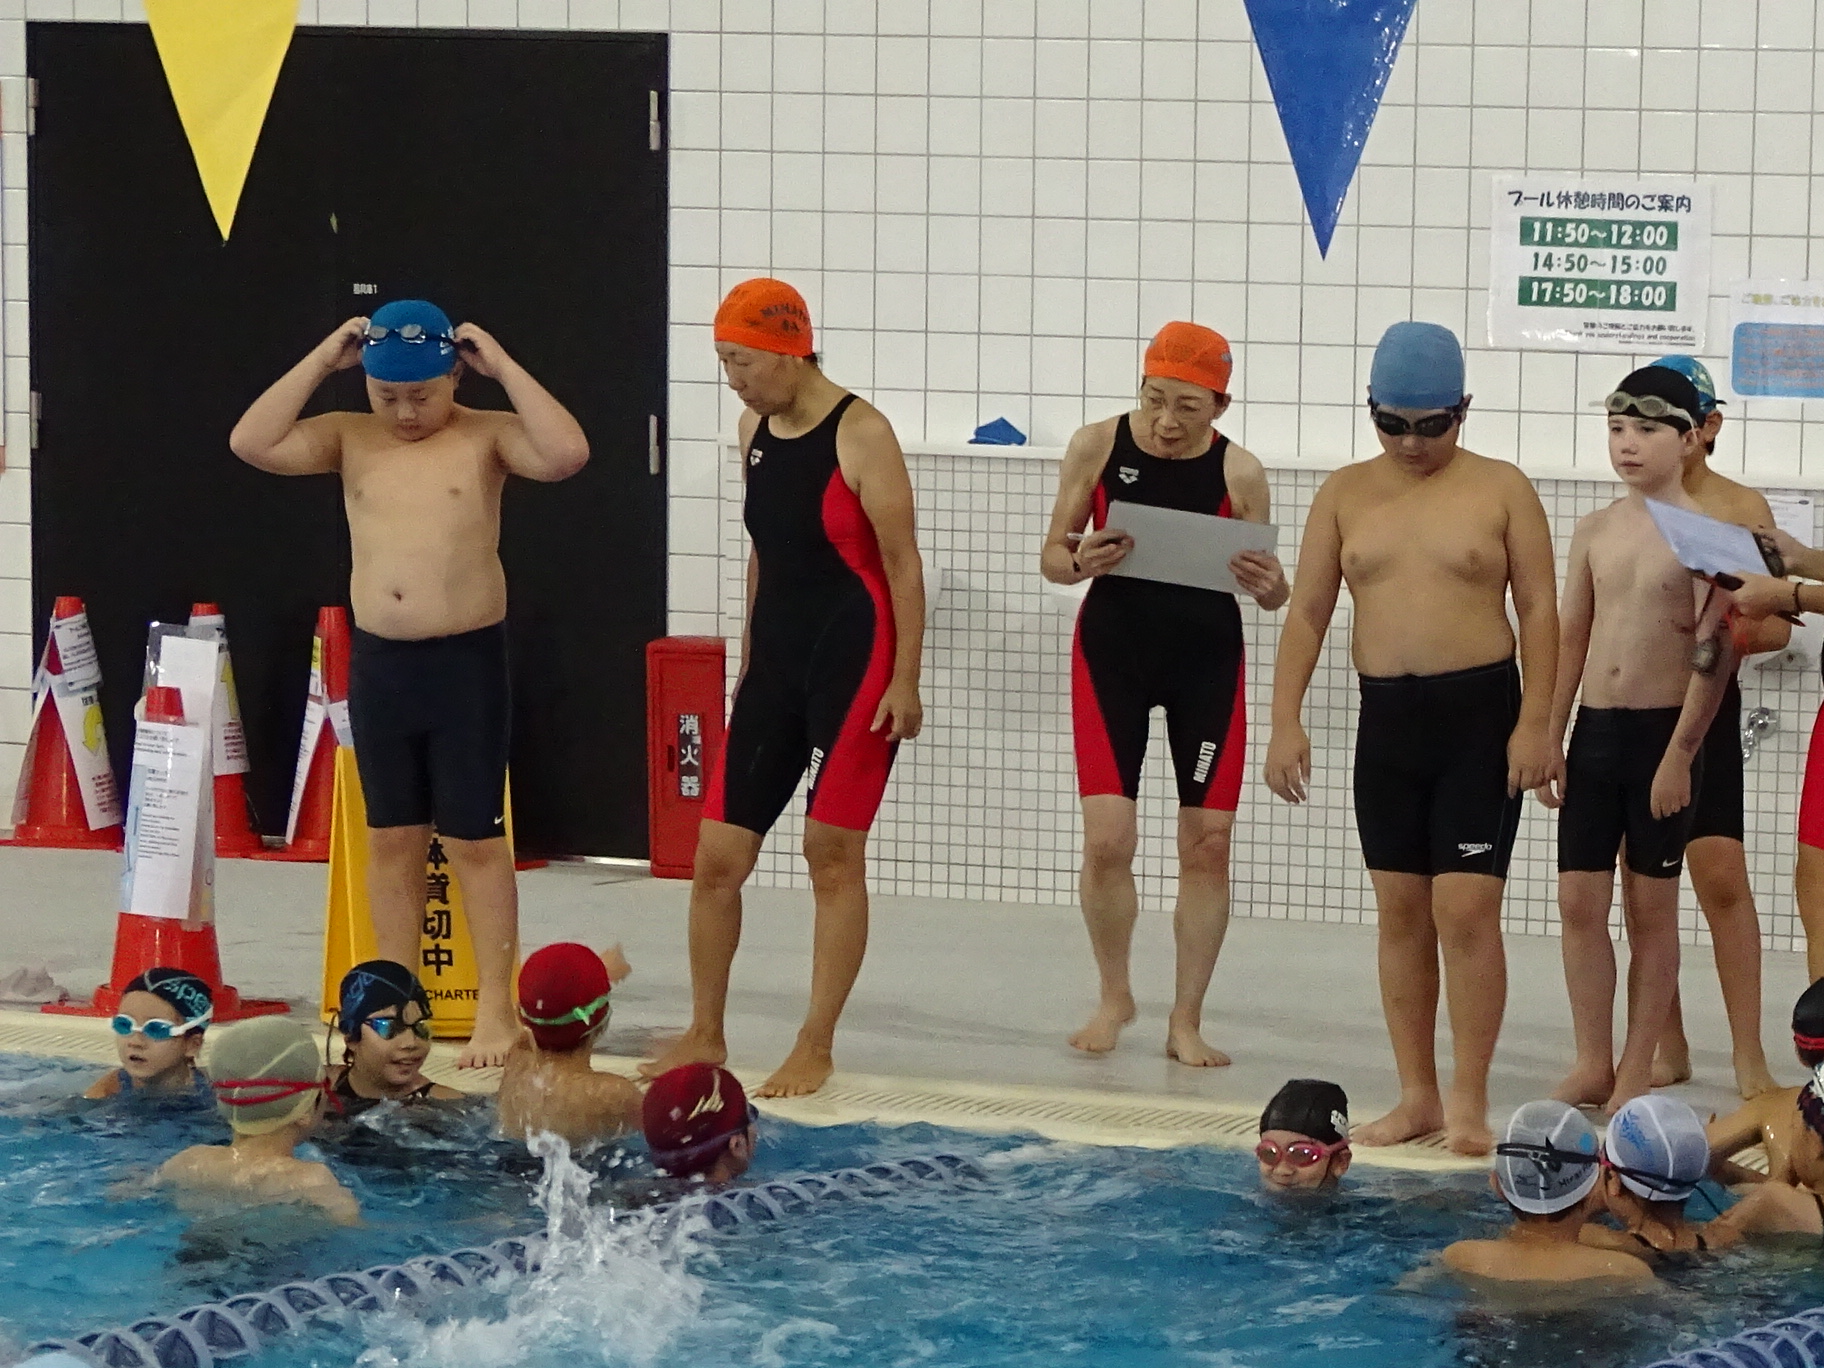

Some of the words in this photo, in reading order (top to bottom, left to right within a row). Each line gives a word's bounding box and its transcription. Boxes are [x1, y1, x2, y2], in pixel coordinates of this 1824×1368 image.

[679, 714, 700, 796] 消火器
[1193, 741, 1217, 783] MINATO
[426, 989, 480, 1001] CHARTE
